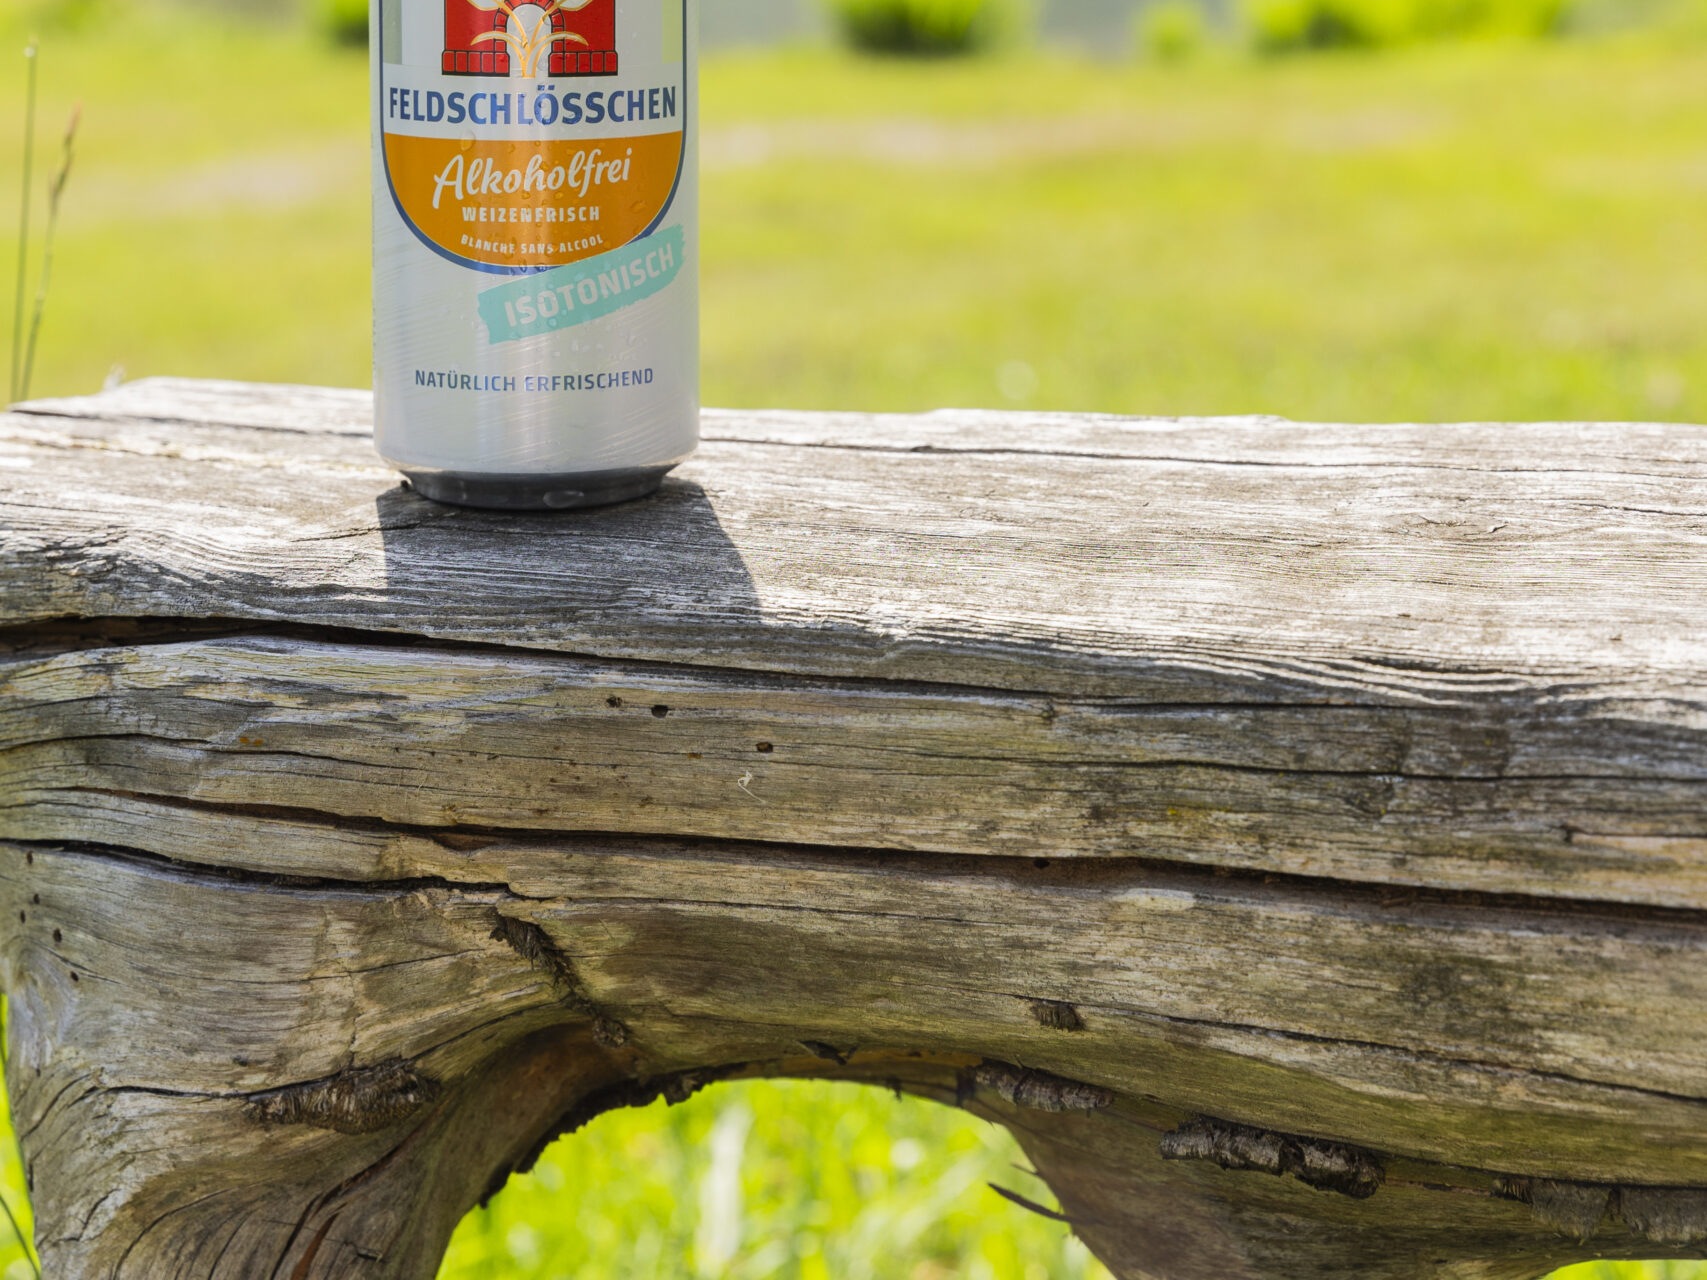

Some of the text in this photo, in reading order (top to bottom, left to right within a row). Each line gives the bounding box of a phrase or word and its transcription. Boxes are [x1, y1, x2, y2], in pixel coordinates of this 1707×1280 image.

[389, 84, 676, 125] FELDSCHLÖSSCHEN
[432, 147, 633, 209] Alkoholfrei
[462, 206, 600, 223] WEIZENFRISCH
[461, 234, 604, 255] BLANCHE SANS ALCOOL
[504, 243, 675, 327] ISOTONISCH
[415, 368, 654, 392] NATÜRLICH ERFRISCHEND
